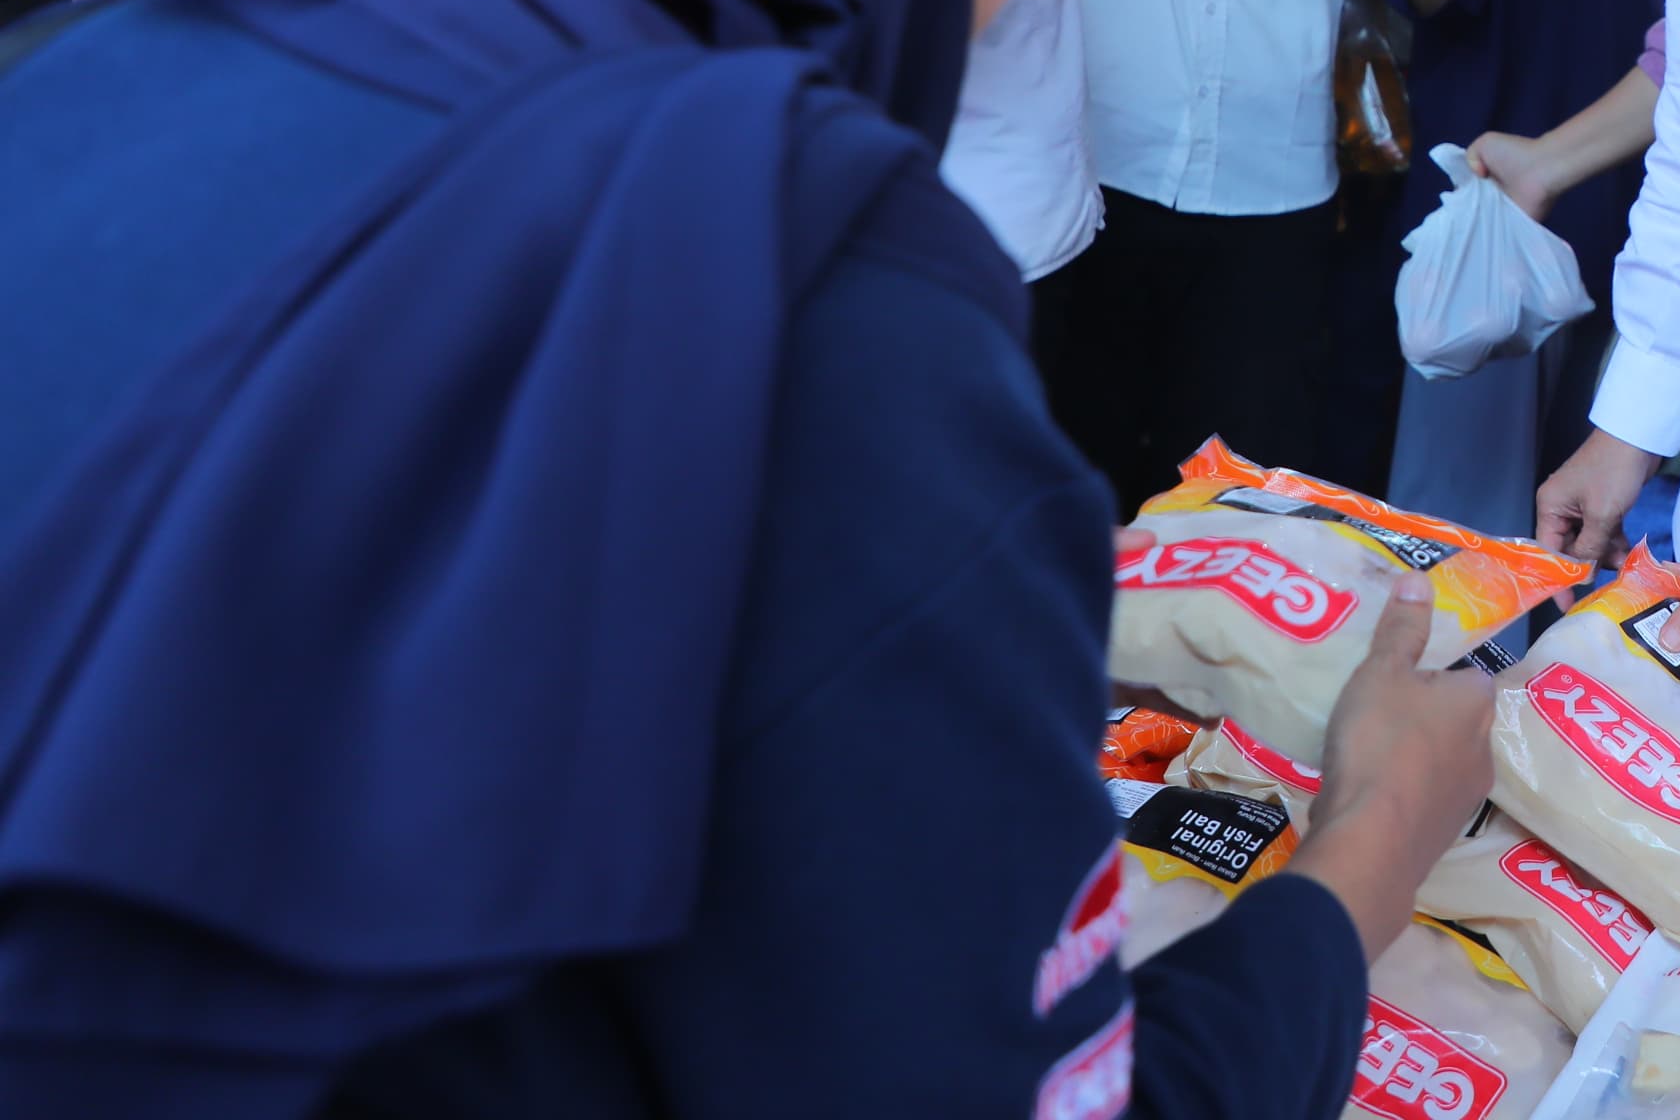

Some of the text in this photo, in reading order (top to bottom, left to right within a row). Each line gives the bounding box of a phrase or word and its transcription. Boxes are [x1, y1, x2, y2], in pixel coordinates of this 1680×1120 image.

[1119, 545, 1325, 624] GEEZY
[1170, 826, 1248, 870] Original
[1179, 809, 1221, 835] Ball
[1220, 825, 1263, 852] Fish
[1516, 859, 1649, 956] EEZY
[1353, 1017, 1471, 1120] GEE
